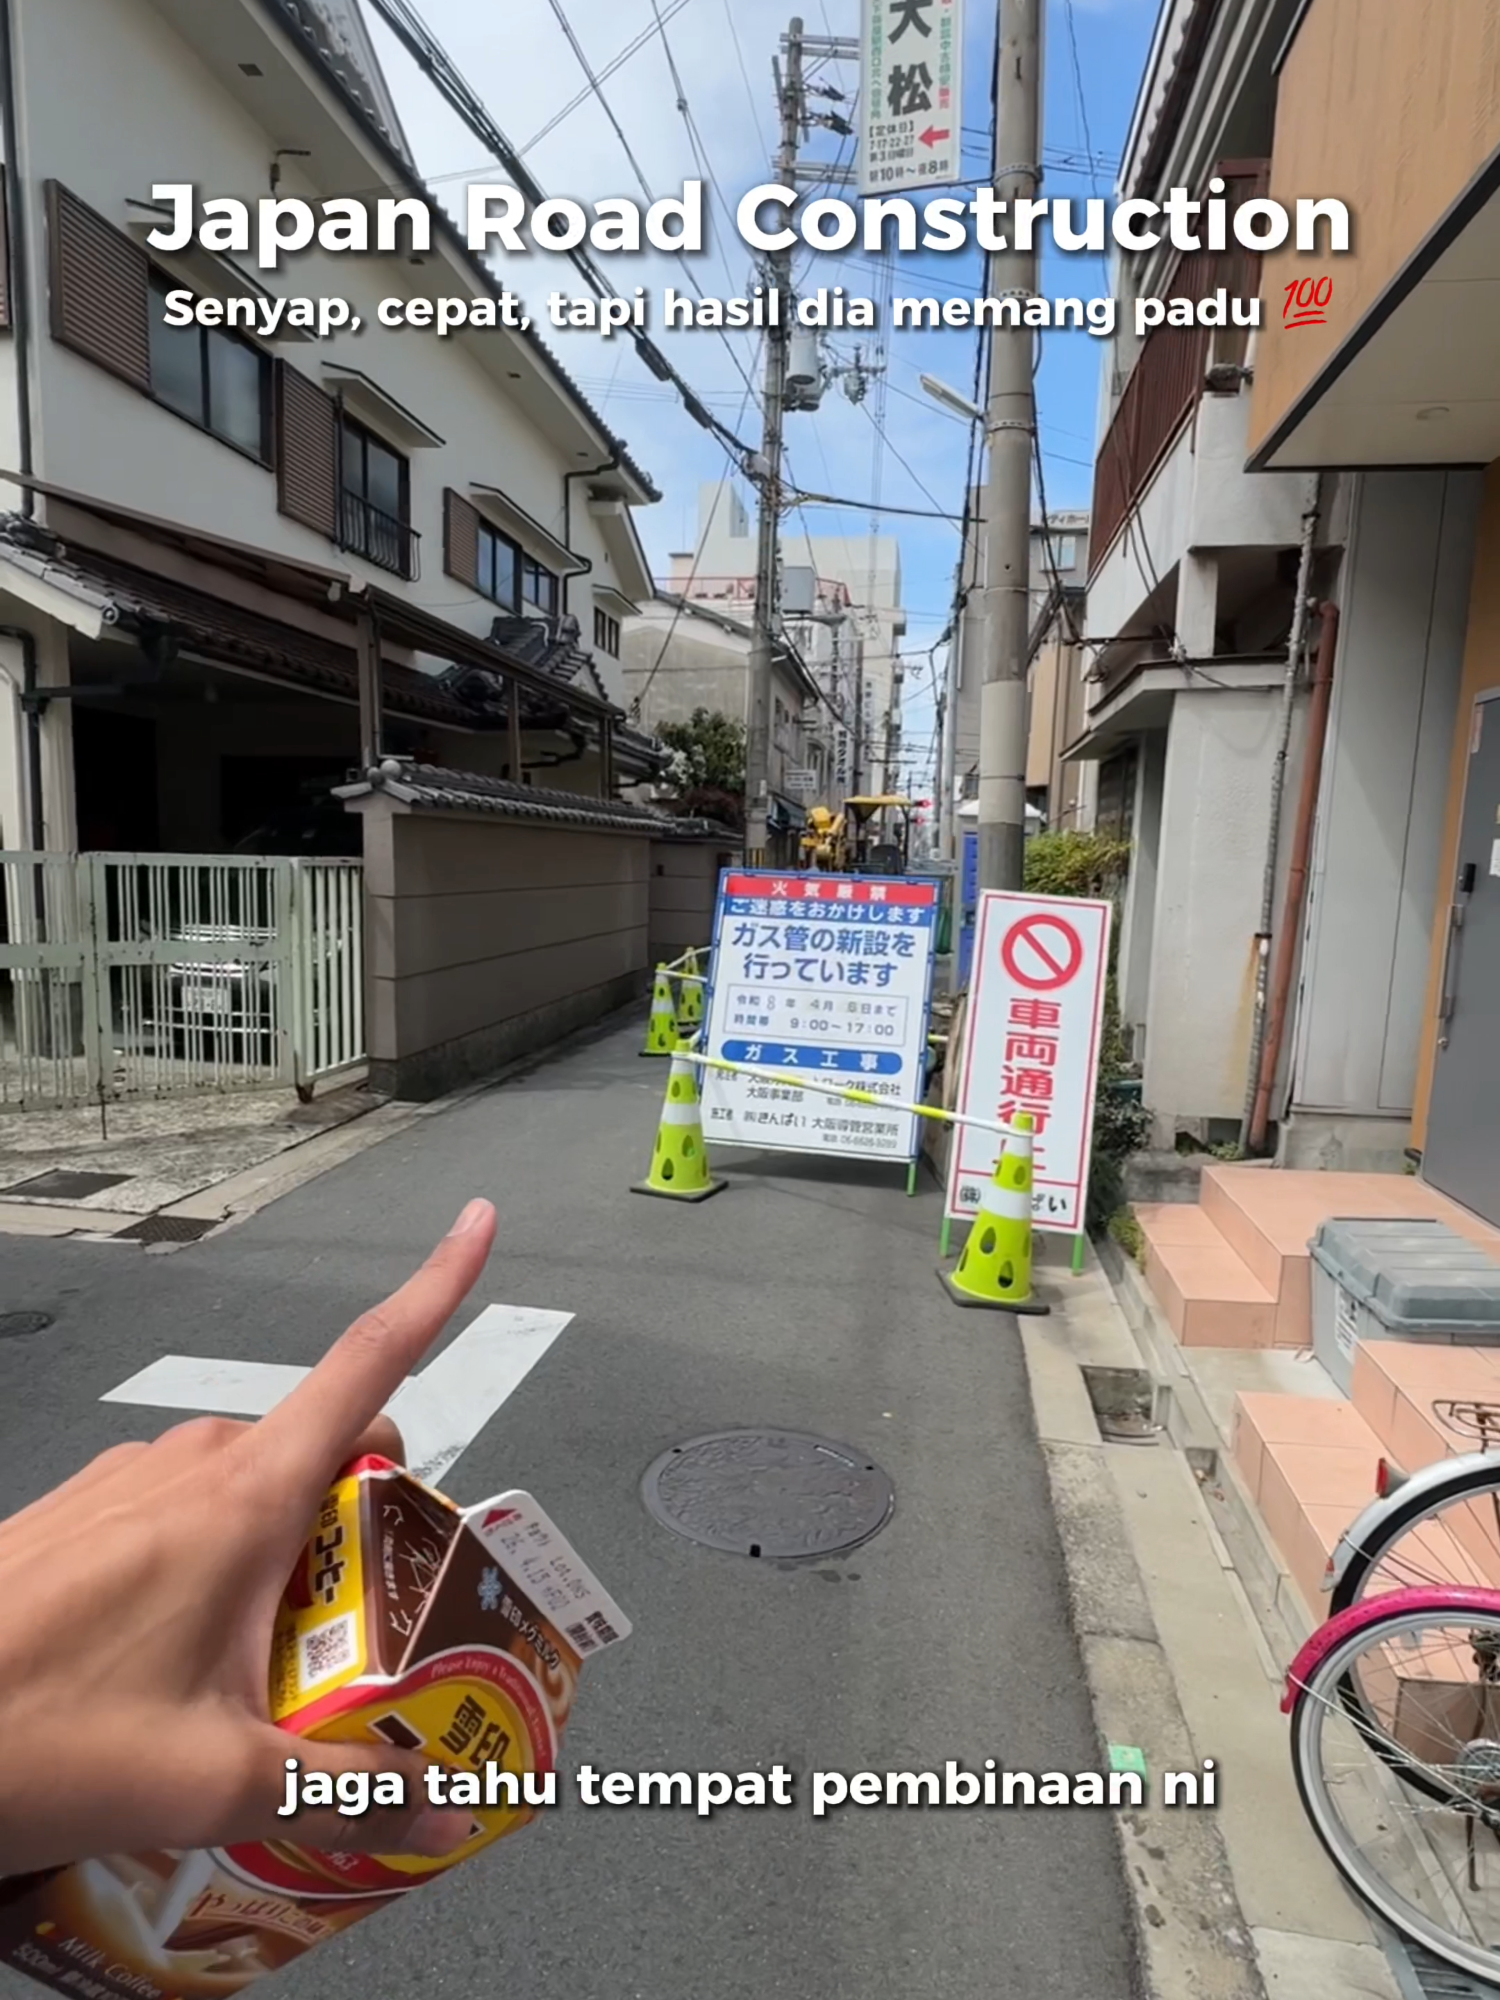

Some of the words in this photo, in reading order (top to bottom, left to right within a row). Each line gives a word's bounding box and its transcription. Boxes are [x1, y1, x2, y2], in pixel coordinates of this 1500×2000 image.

[731, 898, 925, 923] ご迷惑をおかけします
[732, 923, 916, 957] ガス管の新設を
[743, 952, 898, 987] 行っています
[744, 1044, 879, 1071] ガス工事
[500, 1594, 561, 1670] 雪印メグミルク
[438, 1694, 511, 1768] 雪印
